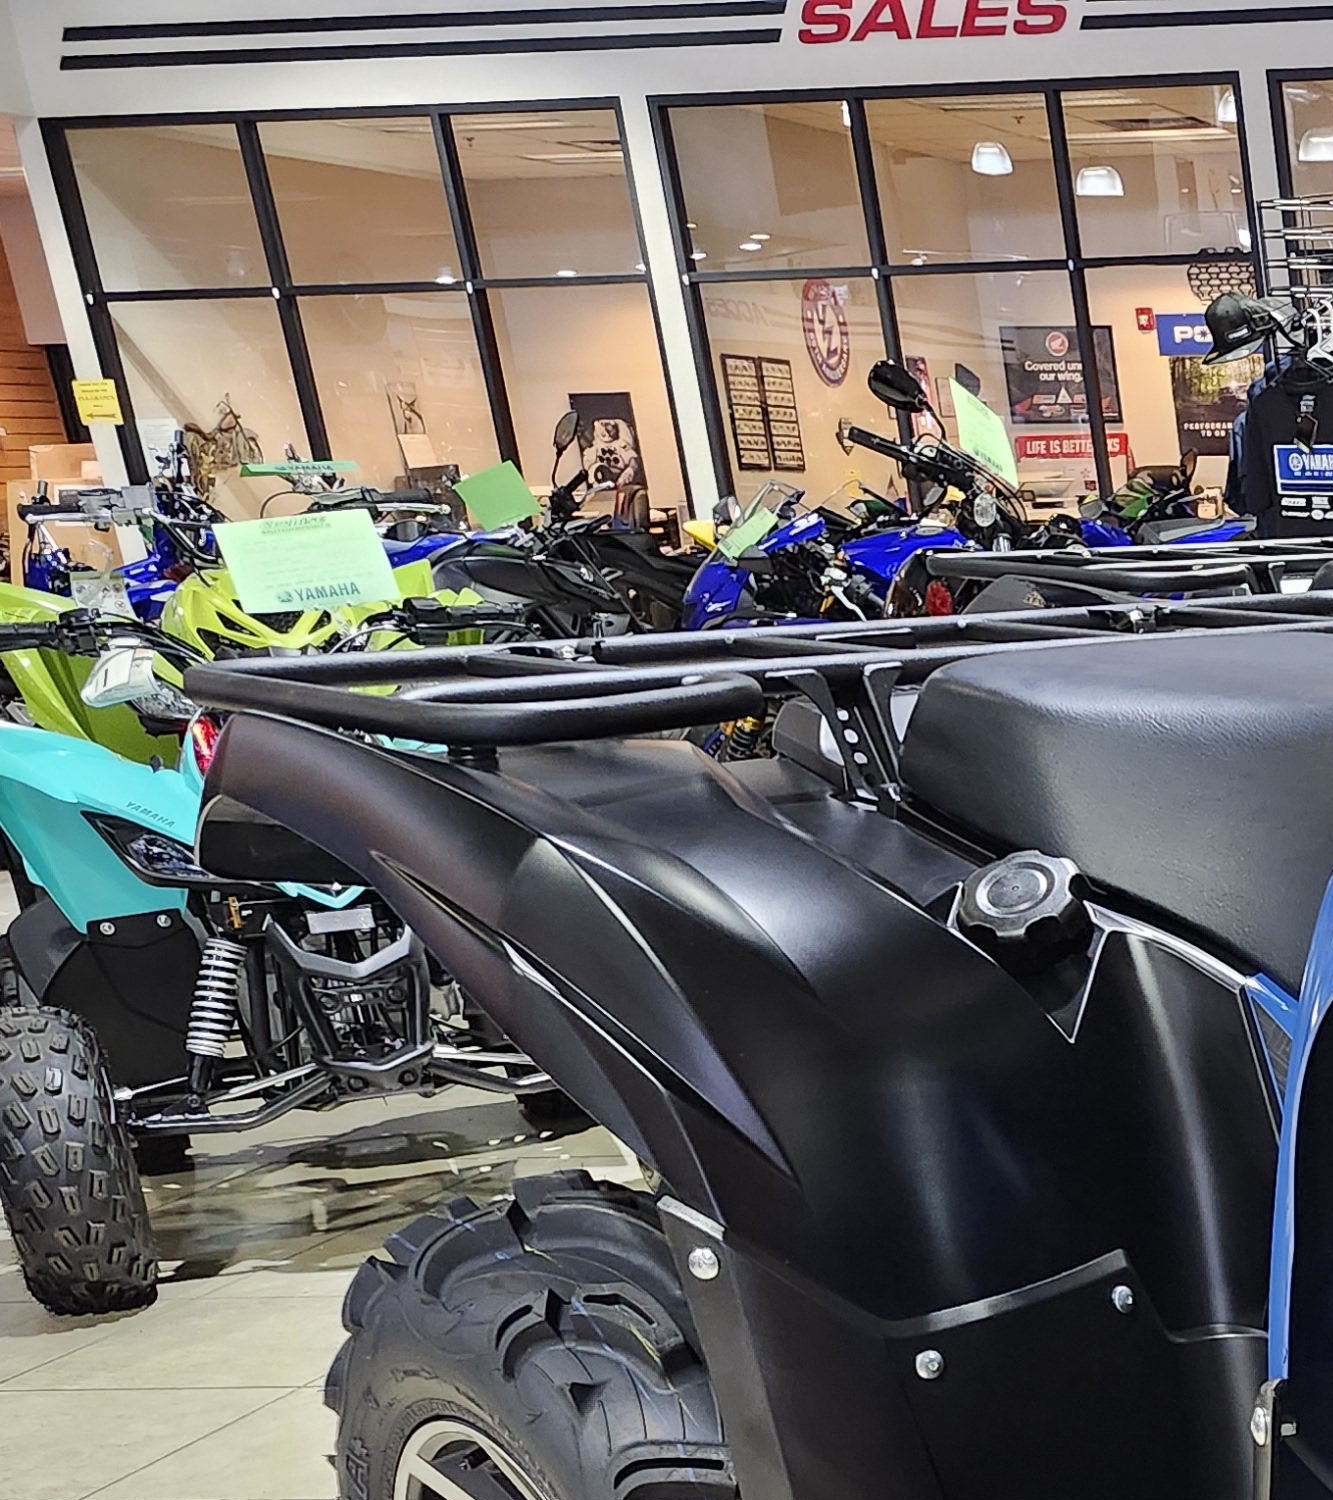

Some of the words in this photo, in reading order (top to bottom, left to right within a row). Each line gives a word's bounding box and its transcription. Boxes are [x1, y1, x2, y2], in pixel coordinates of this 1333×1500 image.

[798, 0, 1067, 44] SALES
[1025, 361, 1065, 371] Covered
[1039, 373, 1056, 381] our
[1183, 422, 1233, 430] PERFORMAN
[1027, 440, 1046, 454] LIFE
[1050, 440, 1061, 453] IS
[1062, 440, 1093, 453] BETTE
[295, 581, 360, 601] YAMAHA
[126, 801, 175, 827] YAMAHA
